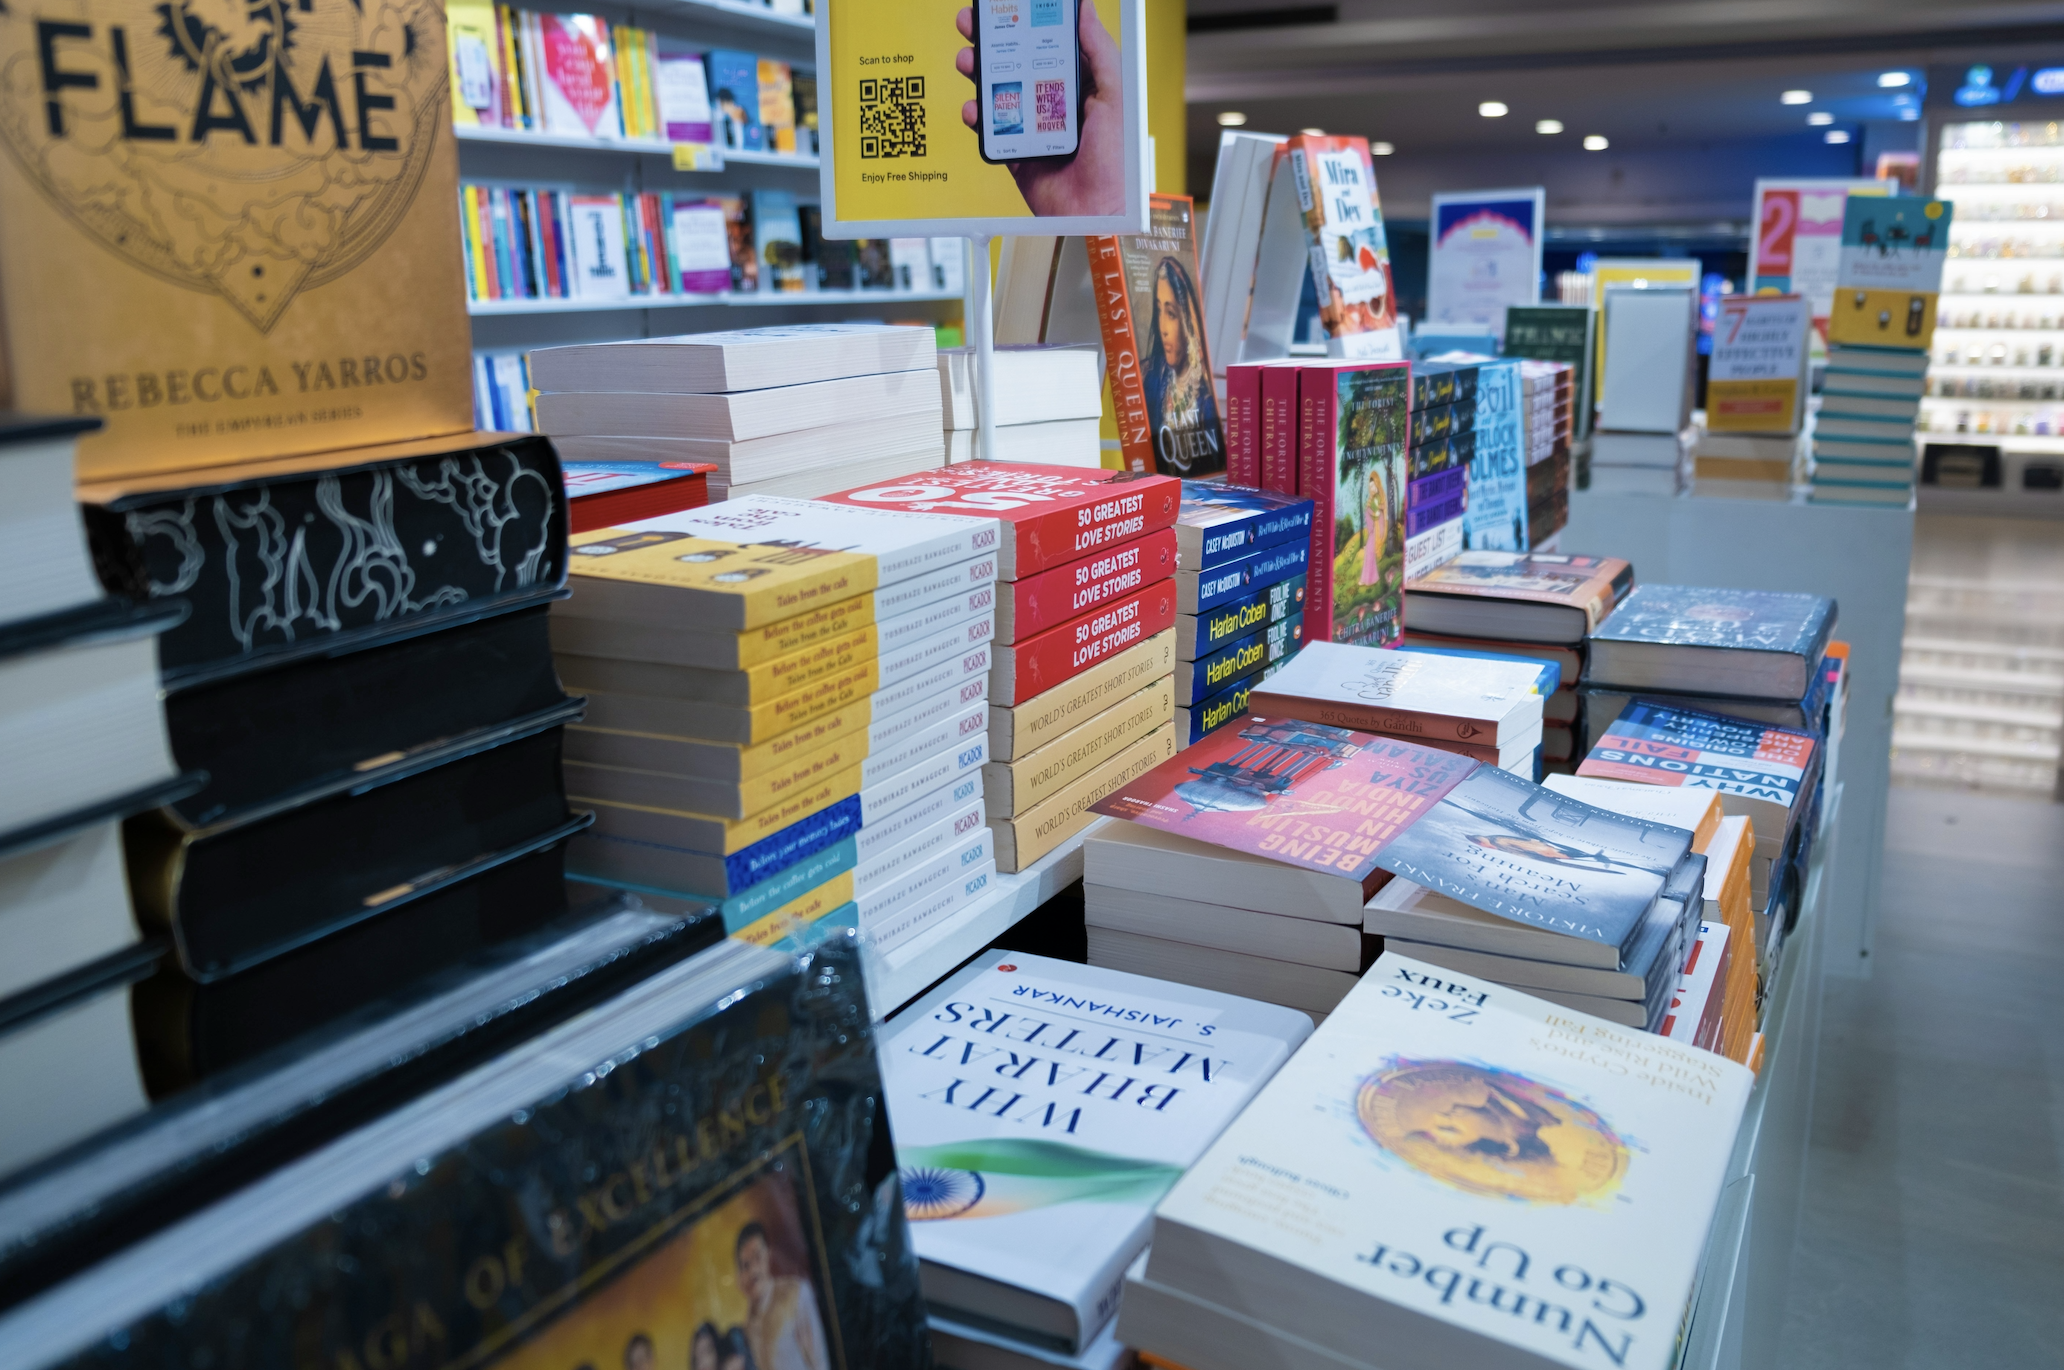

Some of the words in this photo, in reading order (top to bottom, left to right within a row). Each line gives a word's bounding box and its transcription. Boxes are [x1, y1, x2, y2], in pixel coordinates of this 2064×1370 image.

[991, 4, 1018, 15] Habits
[859, 56, 880, 65] Scan
[882, 55, 891, 64] to
[893, 53, 914, 64] shop
[35, 17, 398, 151] FLAME
[994, 92, 1020, 102] SILENT
[1036, 84, 1043, 93] IT
[1045, 82, 1065, 92] ENDS
[1036, 93, 1056, 104] WITH
[994, 101, 1021, 111] PATIENT
[1036, 104, 1047, 114] US
[1037, 121, 1064, 131] HOOVER
[862, 172, 885, 184] Enjoy
[887, 171, 906, 182] Free
[908, 170, 948, 183] Shipping
[1324, 159, 1360, 186] Mira
[1335, 198, 1362, 223] Dev
[1104, 272, 1131, 338] LAST
[70, 364, 281, 415] REBECCA
[291, 351, 429, 393] YARROS
[1117, 351, 1148, 445] QUEEN
[1172, 408, 1200, 429] LAST
[1278, 399, 1287, 426] THE
[1304, 398, 1313, 453] CHITRA
[1316, 399, 1325, 426] THE
[1159, 425, 1220, 471] QUEEN
[1278, 430, 1287, 482] FOREST
[1316, 430, 1325, 482] FOREST
[1078, 507, 1091, 527] 50
[1093, 494, 1144, 523] GREATEST
[1075, 528, 1102, 551] LOVE
[1104, 515, 1144, 545] STORIES
[1205, 535, 1221, 555] CASEY
[1221, 529, 1246, 551] McQUISTON
[882, 556, 923, 574] TOSHIKAZU
[924, 543, 962, 561] KAWAGUCHI
[972, 528, 995, 550] PICADOR
[1076, 567, 1089, 586] 50
[1091, 548, 1140, 580] GREATEST
[1313, 501, 1324, 613] ENCHANTMENTS
[777, 592, 798, 608] Tales
[801, 587, 818, 602] from
[820, 582, 831, 596] the
[881, 588, 922, 608] TOSHIKAZU
[924, 574, 961, 593] KAWAGUCHI
[970, 560, 994, 582] PICADOR
[969, 588, 992, 611] PICADOR
[1073, 587, 1100, 610] LOVE
[1102, 569, 1141, 602] STORIES
[1201, 578, 1217, 600] CASEY
[1217, 571, 1241, 594] McQUISTON
[1269, 585, 1281, 603] FOOL
[1076, 625, 1089, 644] 50
[1091, 600, 1140, 637] GREATEST
[1209, 614, 1238, 641] Harlan
[1239, 603, 1266, 628] Coben
[1271, 600, 1287, 622] ONCE
[968, 619, 991, 642] PICADOR
[1073, 644, 1100, 667] LOVE
[1102, 621, 1141, 653] STORIES
[963, 651, 986, 673] PICADOR
[1206, 659, 1236, 686] Harlan
[1237, 643, 1264, 670] Coben
[960, 680, 983, 704] PICADOR
[1030, 704, 1066, 733] WORLD'S
[1066, 685, 1102, 714] GREATEST
[1103, 673, 1127, 695] SHORT
[1128, 657, 1154, 680] STORIES
[959, 712, 984, 736] PICADOR
[1202, 703, 1232, 732] Harlan
[1319, 711, 1335, 721] 365
[1338, 712, 1368, 727] Quotes
[1369, 716, 1380, 728] by
[1383, 717, 1423, 733] Gandhi
[1652, 713, 1752, 736] POVERTY
[1759, 731, 1806, 744] AND
[1030, 758, 1066, 789] WORLD'S
[1066, 736, 1102, 768] GREATEST
[1103, 723, 1127, 746] SHORT
[1127, 705, 1153, 731] STORIES
[1610, 738, 1690, 758] FAIL
[1651, 733, 1745, 755] ORIGINS
[1751, 751, 1797, 764] THE
[1664, 722, 1803, 750] PROSPERITY
[1769, 747, 1800, 757] OF
[1365, 741, 1460, 769] SALAM
[1599, 750, 1788, 788] NATIONS
[867, 785, 909, 812] TOSHIKAZU
[911, 765, 950, 791] KAWAGUCHI
[958, 745, 983, 769] PICADOR
[953, 780, 975, 802] PICADOR
[1370, 770, 1439, 795] ZIYA
[1408, 766, 1449, 782] US
[1689, 780, 1783, 802] WHY
[1035, 807, 1071, 840] WORLD'S
[1071, 783, 1107, 816] GREATEST
[1107, 769, 1131, 793] SHORT
[1131, 750, 1157, 776] STORIES
[1122, 795, 1153, 807] THAROOR
[1153, 803, 1179, 814] SHASHI
[1307, 791, 1412, 826] HINDU
[1340, 778, 1425, 810] INDIA
[1492, 768, 1529, 788] SOLD
[1533, 791, 1583, 809] COPIES
[1589, 808, 1655, 829] MILLION
[954, 809, 980, 836] PICADOR
[1249, 811, 1381, 852] MUSLIM
[1357, 819, 1398, 839] IN
[750, 850, 777, 871] Before
[779, 842, 798, 860] your
[829, 814, 850, 830] fades
[961, 844, 984, 867] PICADOR
[1258, 833, 1361, 872] BEING
[965, 873, 988, 896] PICADOR
[1443, 850, 1486, 874] For
[1498, 871, 1590, 907] Search
[1464, 843, 1582, 893] Meaning
[1392, 858, 1480, 903] FRANKL
[1507, 904, 1604, 939] VIKTOR
[1465, 873, 1546, 908] Man's
[1381, 983, 1481, 1026] Zeke
[1395, 967, 1492, 1008] Faux
[1012, 984, 1183, 1028] JAISHANKAR
[1195, 1022, 1216, 1037] S.
[935, 1001, 1234, 1084] MATTERS
[1545, 1013, 1588, 1034] Fall
[1594, 1026, 1723, 1078] Staggering
[1548, 1027, 1594, 1049] and
[1600, 1044, 1649, 1068] Rise
[1657, 1061, 1718, 1092] Wild
[908, 1033, 1186, 1112] BHARAT
[1529, 1038, 1629, 1076] Crypto's
[1637, 1071, 1713, 1106] Inside
[918, 1077, 1083, 1135] WHY
[1442, 1224, 1531, 1281] Up
[1554, 1262, 1648, 1325] Go
[1355, 1241, 1636, 1368] Number
